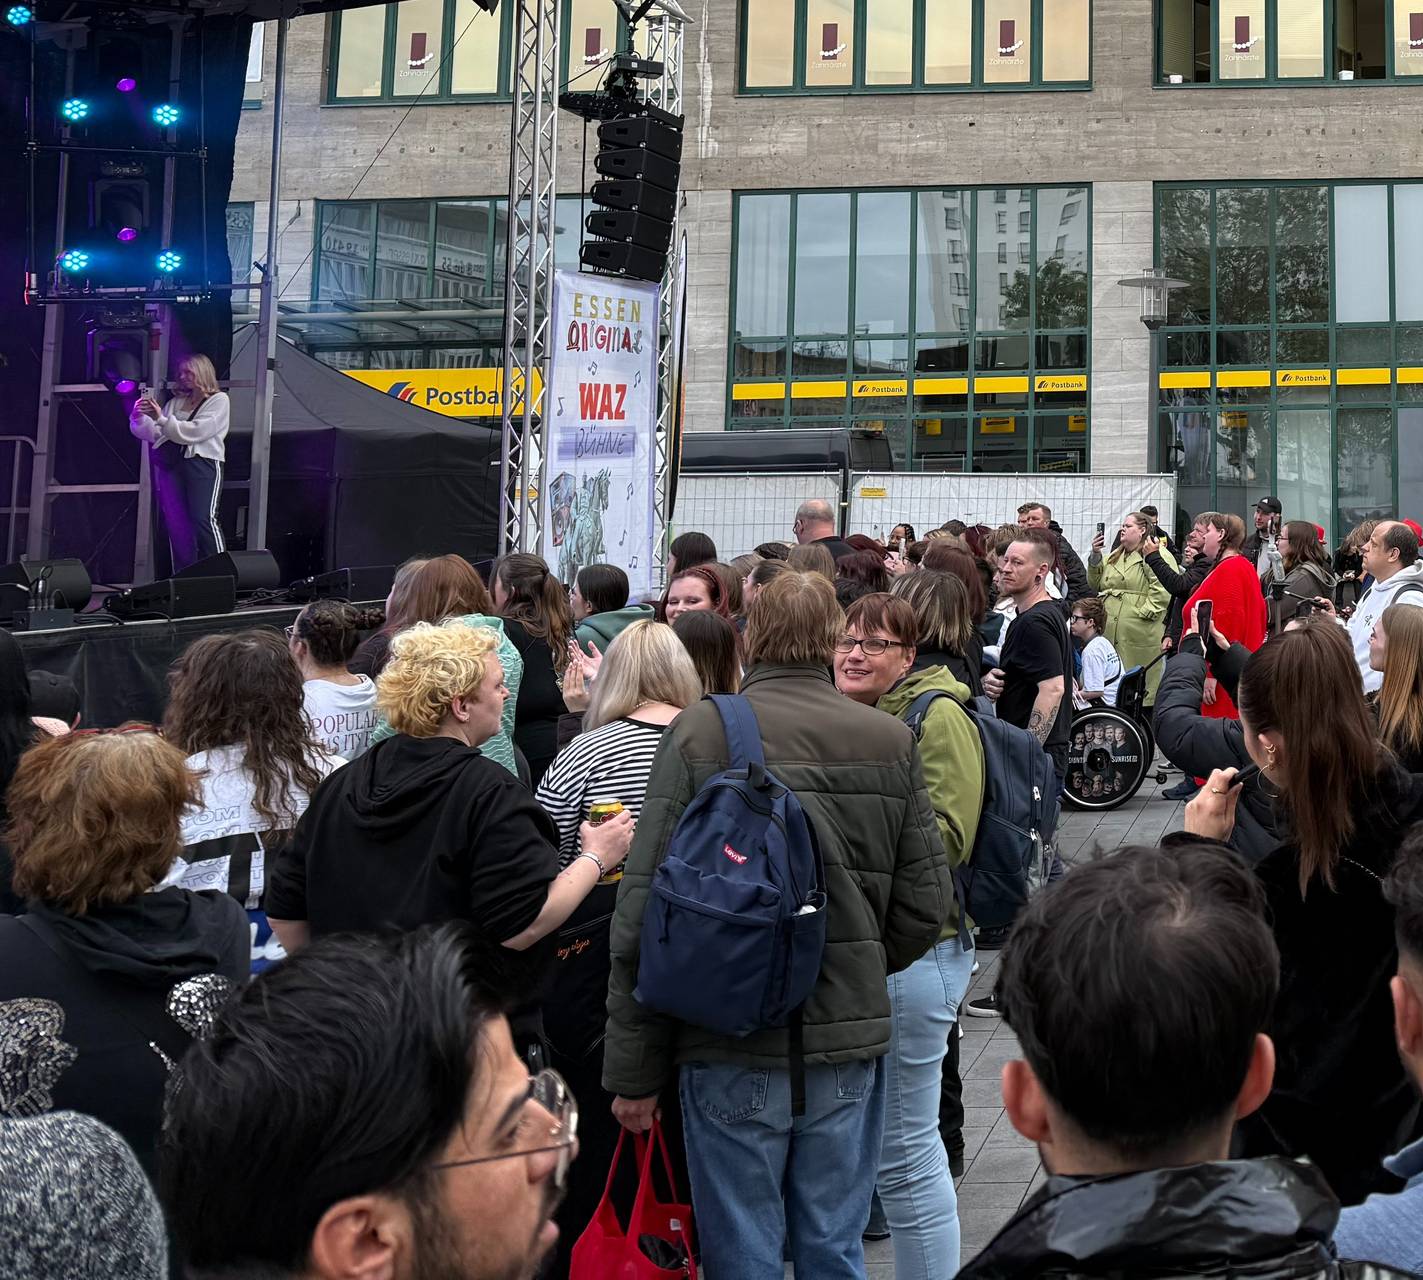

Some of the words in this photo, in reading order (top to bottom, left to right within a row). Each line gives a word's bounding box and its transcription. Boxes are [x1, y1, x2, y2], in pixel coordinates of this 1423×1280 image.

[573, 292, 641, 322] ESSEN
[1051, 380, 1083, 389] Postbank
[1295, 374, 1327, 382] Postbank
[579, 383, 628, 421] WAZ
[575, 426, 629, 458] BÜHNE
